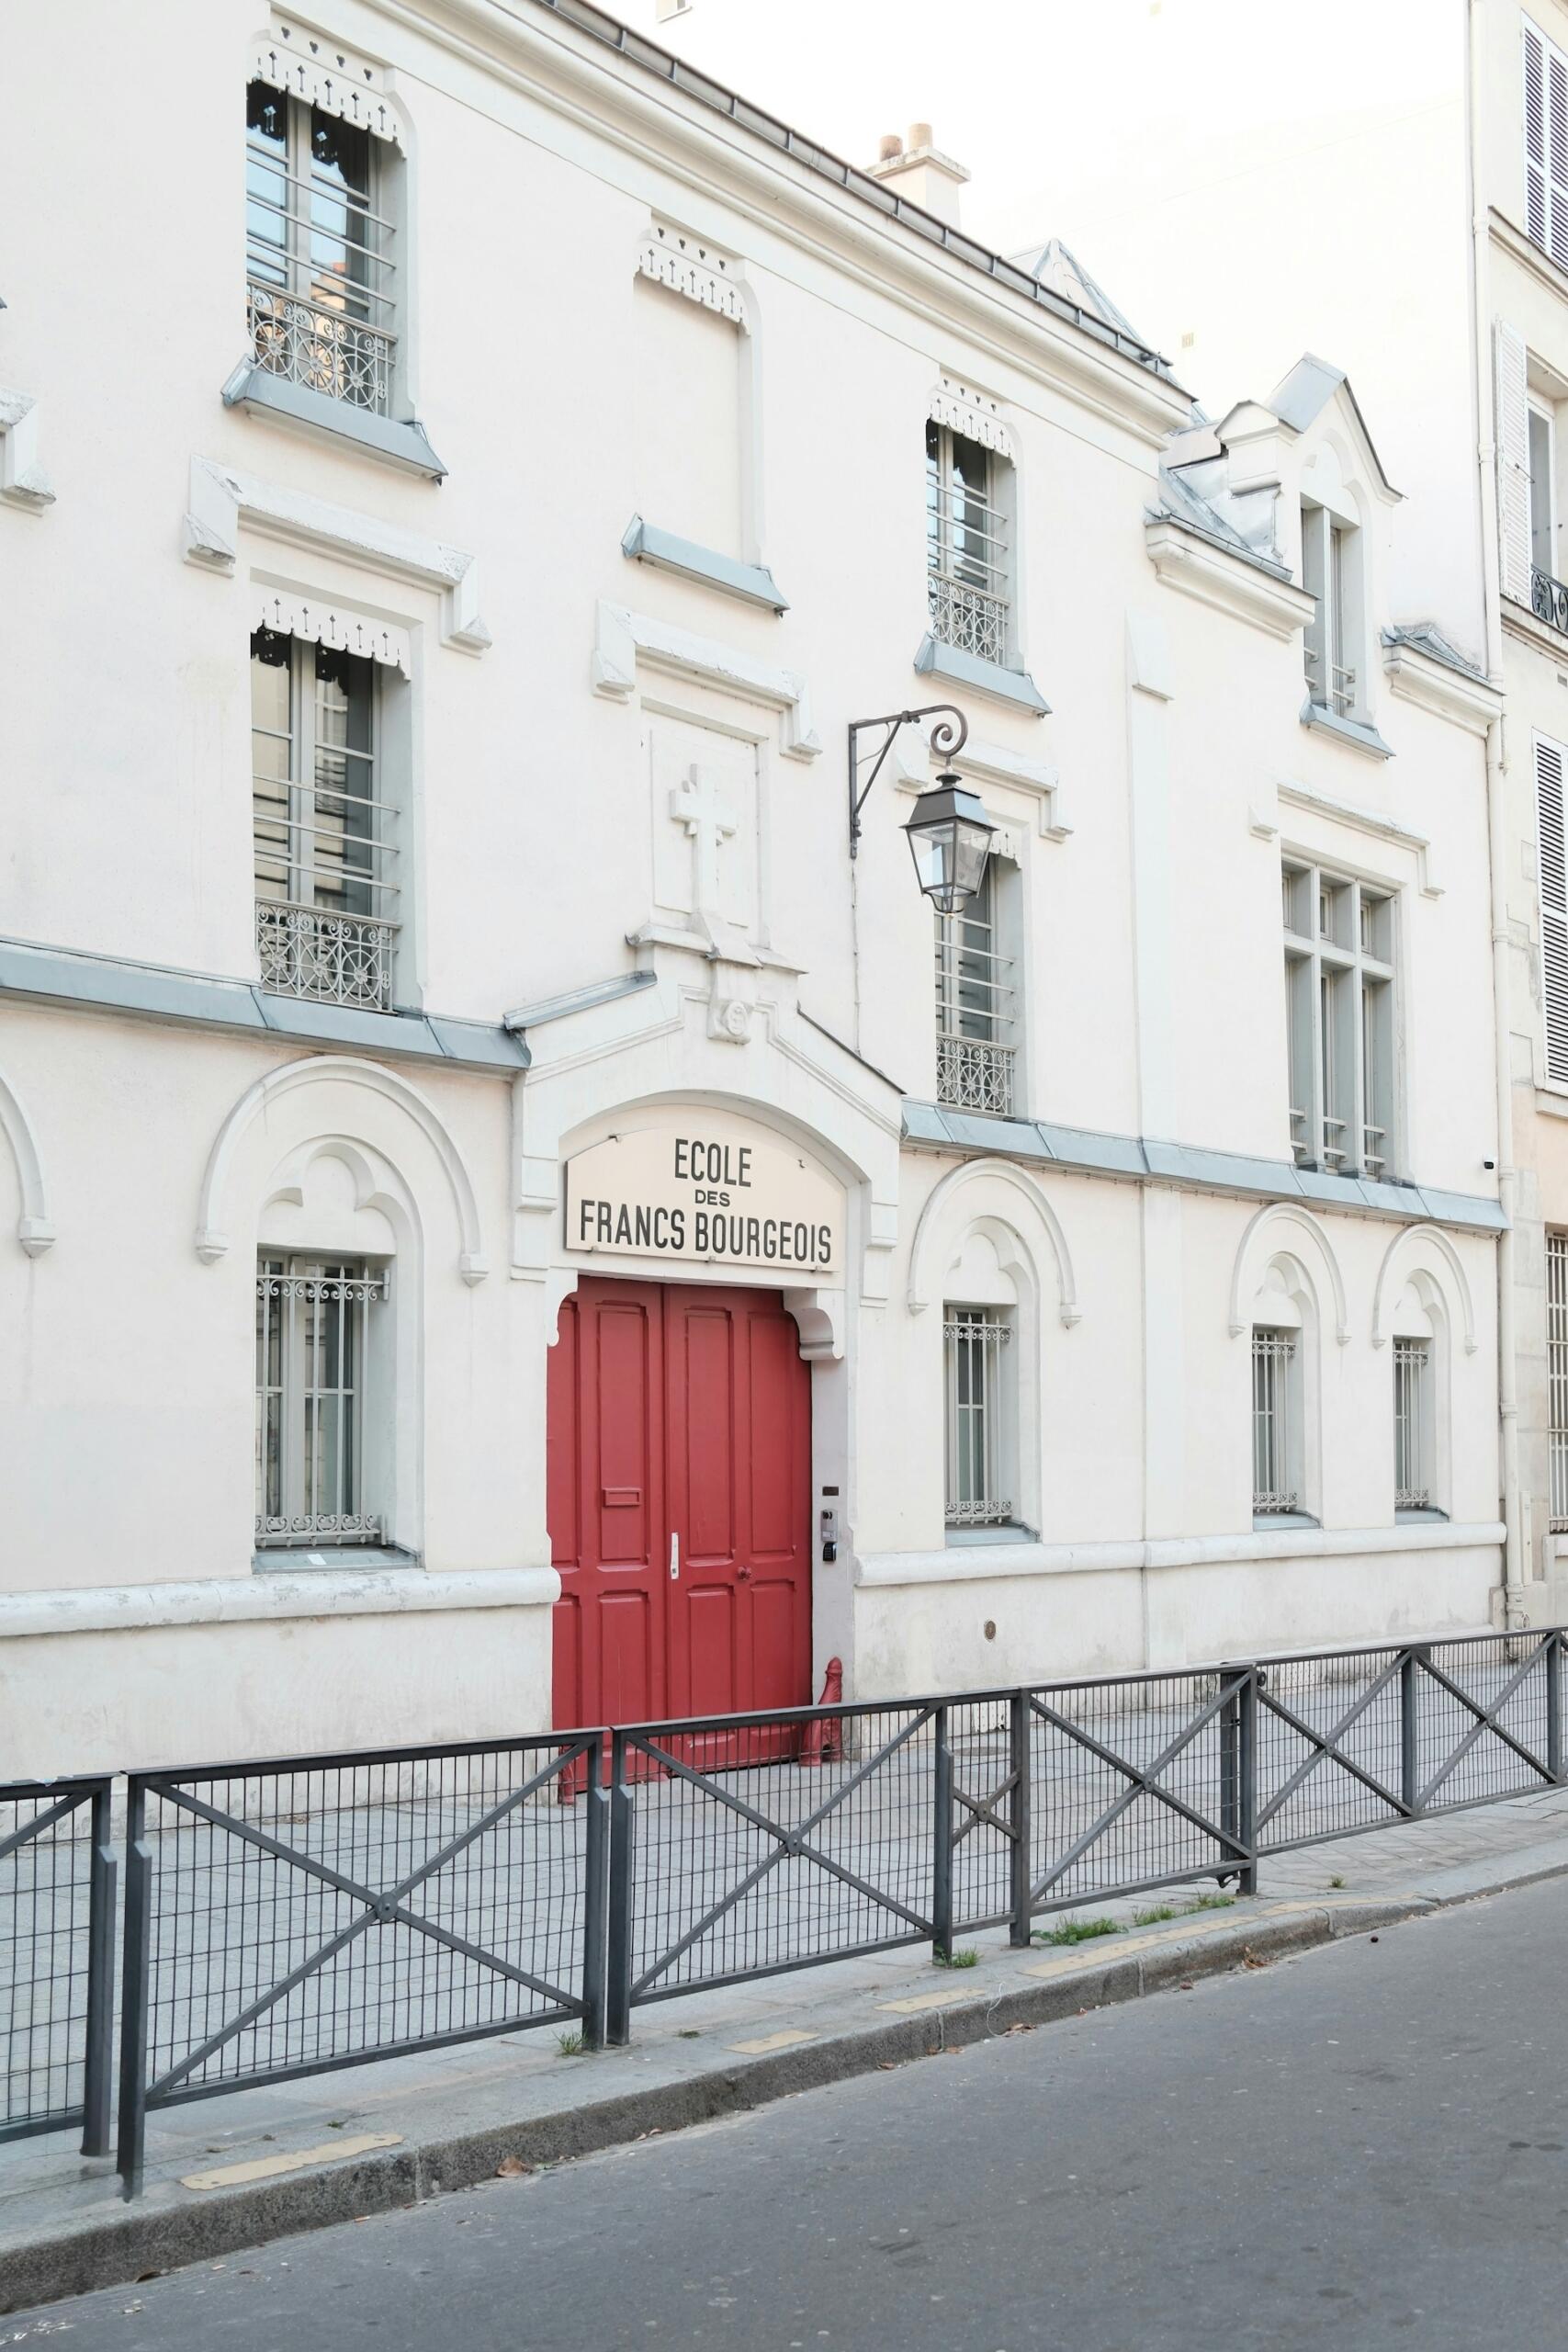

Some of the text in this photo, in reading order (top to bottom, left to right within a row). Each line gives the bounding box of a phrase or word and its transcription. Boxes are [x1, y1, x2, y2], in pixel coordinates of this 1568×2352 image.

[674, 1137, 752, 1188] ECOLE
[694, 1189, 731, 1208] DES
[580, 1198, 832, 1264] FRANCS BOURGEOIS
